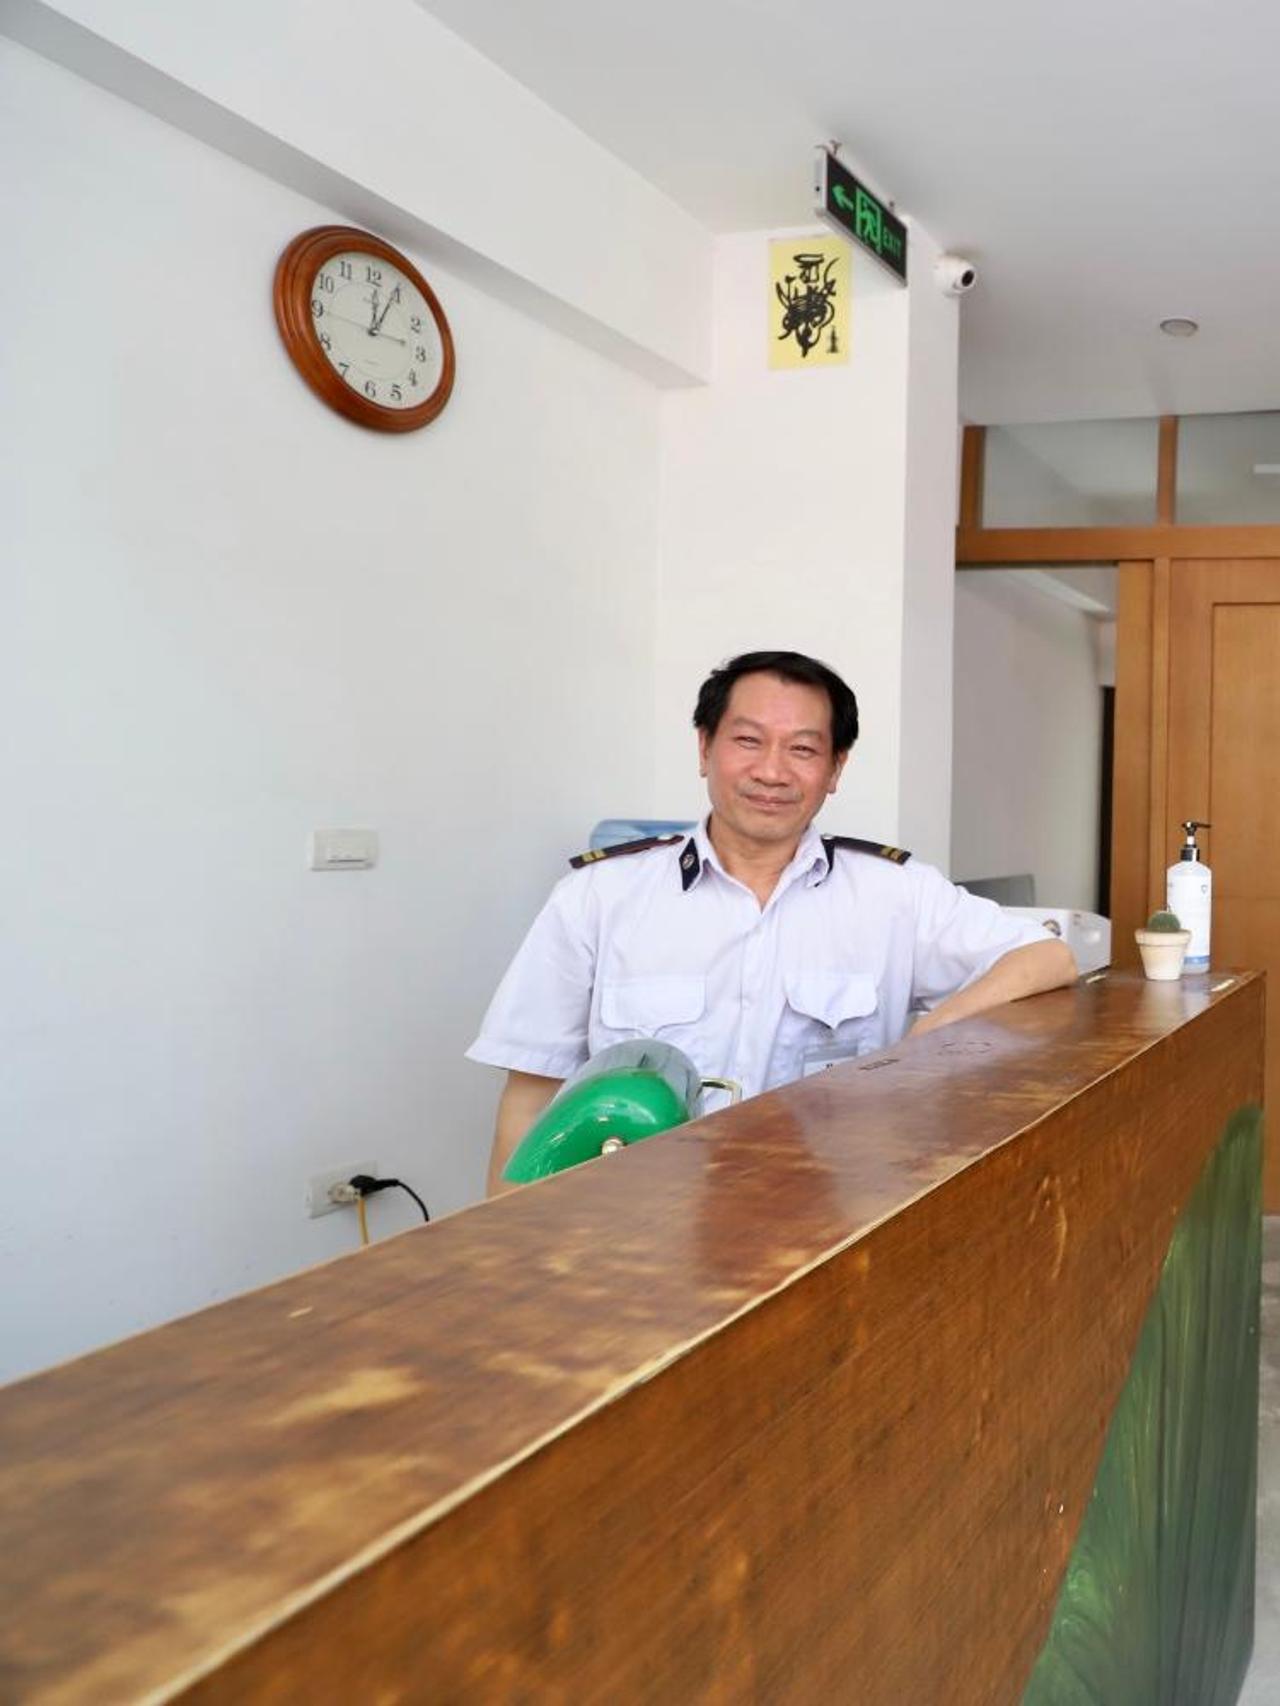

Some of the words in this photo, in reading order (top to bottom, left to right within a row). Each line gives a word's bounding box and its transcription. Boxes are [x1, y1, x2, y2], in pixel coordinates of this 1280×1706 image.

[340, 261, 352, 281] 11
[366, 267, 382, 287] 12
[319, 273, 334, 293] 10
[311, 300, 324, 318] 9
[410, 317, 421, 334] 2
[320, 334, 332, 351] 8
[415, 347, 427, 363] 3
[338, 362, 350, 380] 7
[408, 368, 418, 387] 4
[364, 379, 376, 398] 6
[390, 384, 402, 401] 5
